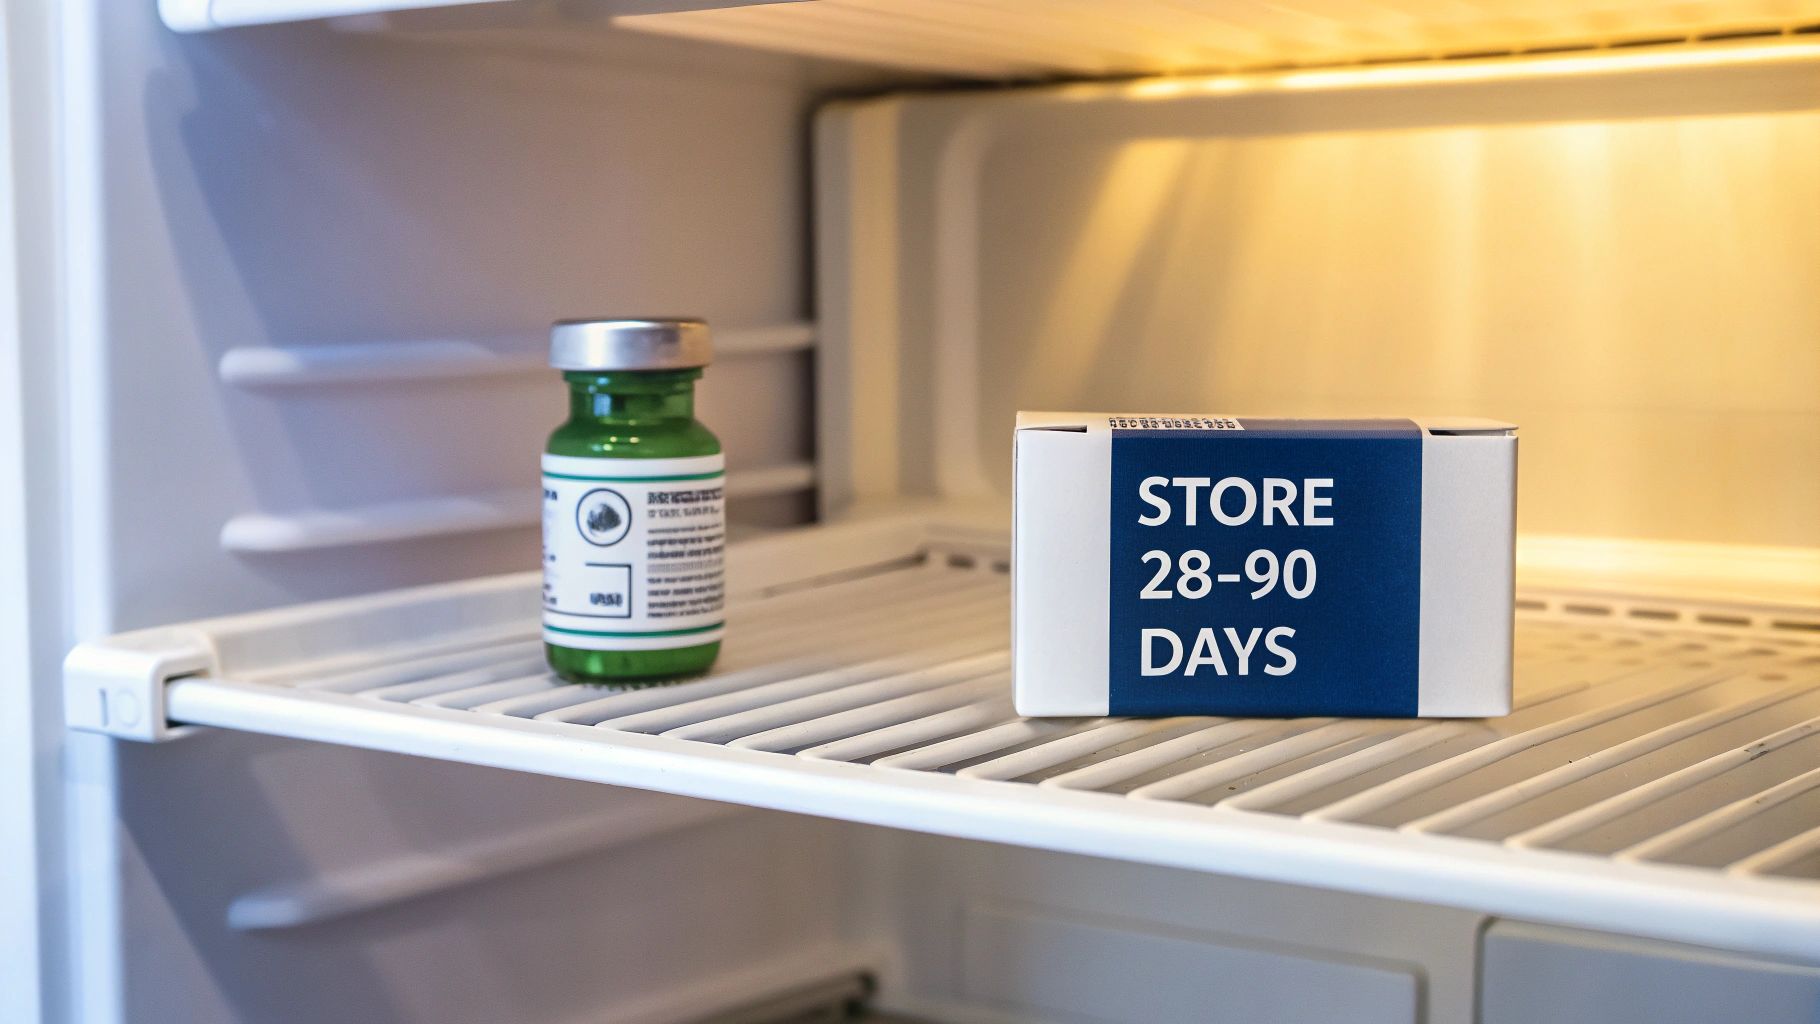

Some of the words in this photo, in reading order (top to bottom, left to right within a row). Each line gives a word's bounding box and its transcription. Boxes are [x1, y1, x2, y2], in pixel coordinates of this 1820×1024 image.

[1137, 476, 1334, 527] STORE
[1139, 548, 1317, 600] 28-90
[1140, 626, 1297, 677] DAYS
